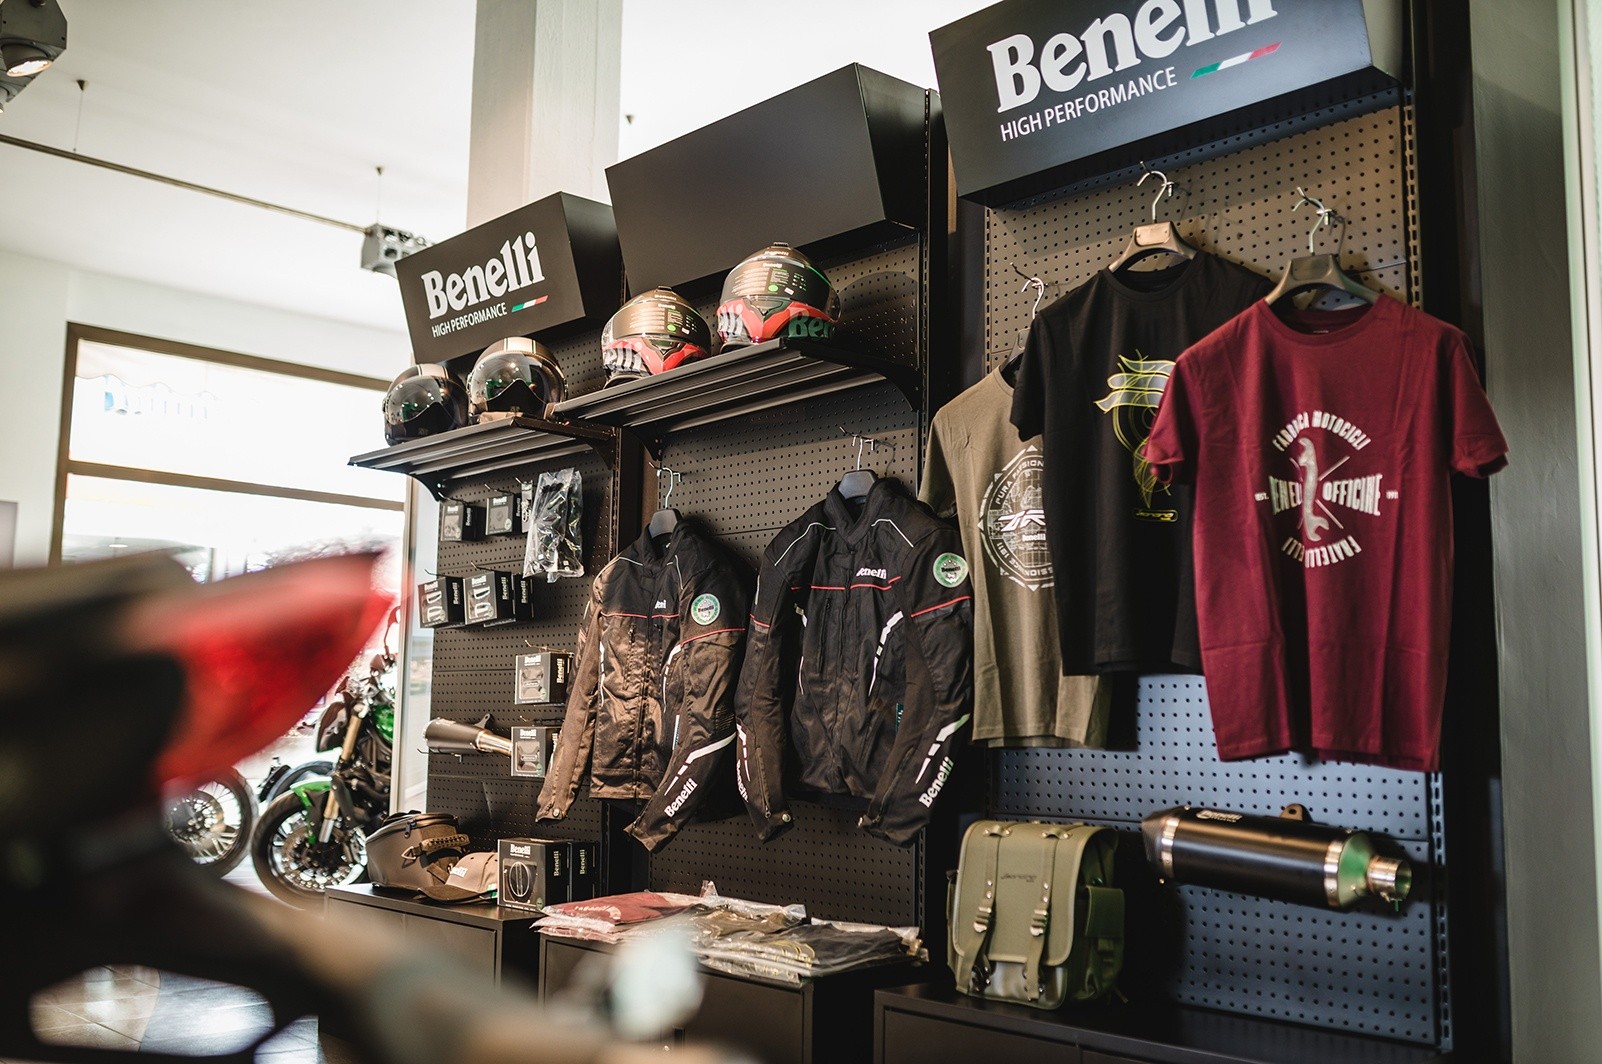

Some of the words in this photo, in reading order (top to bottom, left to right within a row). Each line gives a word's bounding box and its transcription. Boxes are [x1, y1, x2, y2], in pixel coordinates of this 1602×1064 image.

[1000, 113, 1042, 141] HIGH
[1045, 66, 1178, 127] PERFORMANCE
[421, 231, 545, 319] Benelli
[432, 323, 450, 338] HIGH
[450, 302, 508, 331] PERFORMANCE
[1312, 410, 1371, 450] MOTOCICLI
[995, 481, 1013, 504] PURA
[1322, 473, 1383, 516] OFFICINE
[664, 778, 698, 817] Benelli
[918, 756, 955, 808] Benelli
